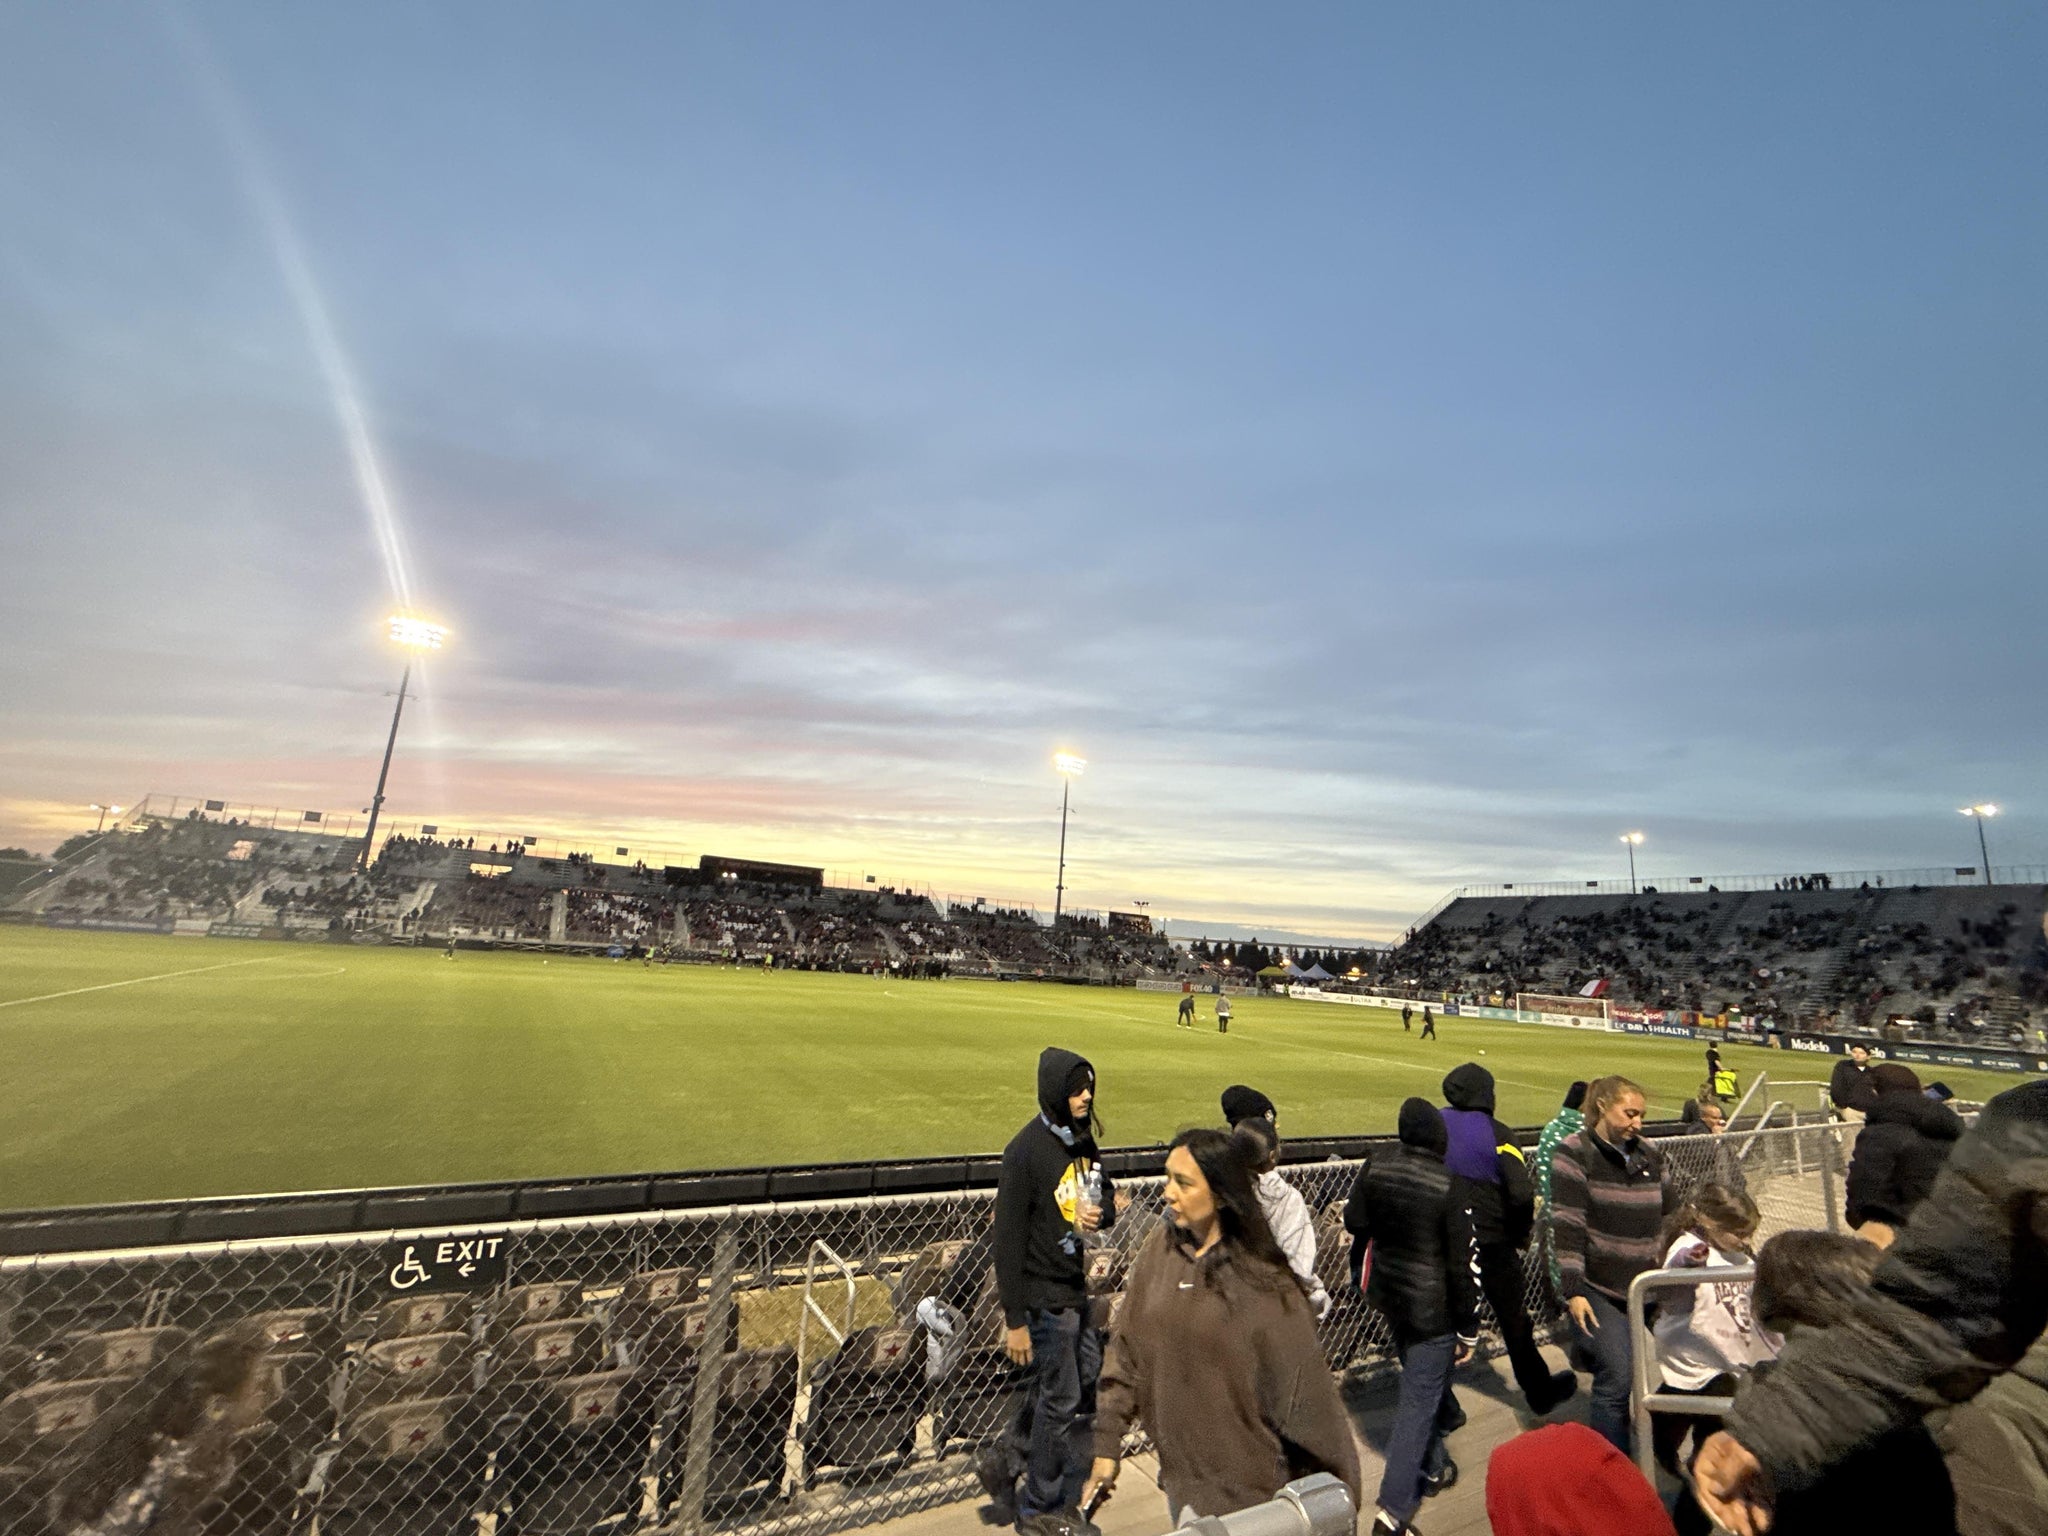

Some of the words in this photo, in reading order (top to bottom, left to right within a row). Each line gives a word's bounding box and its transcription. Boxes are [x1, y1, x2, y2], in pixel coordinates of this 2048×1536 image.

[1653, 1024, 1690, 1036] HEALTH
[1791, 1038, 1830, 1053] Modelo
[436, 1238, 503, 1263] EXIT
